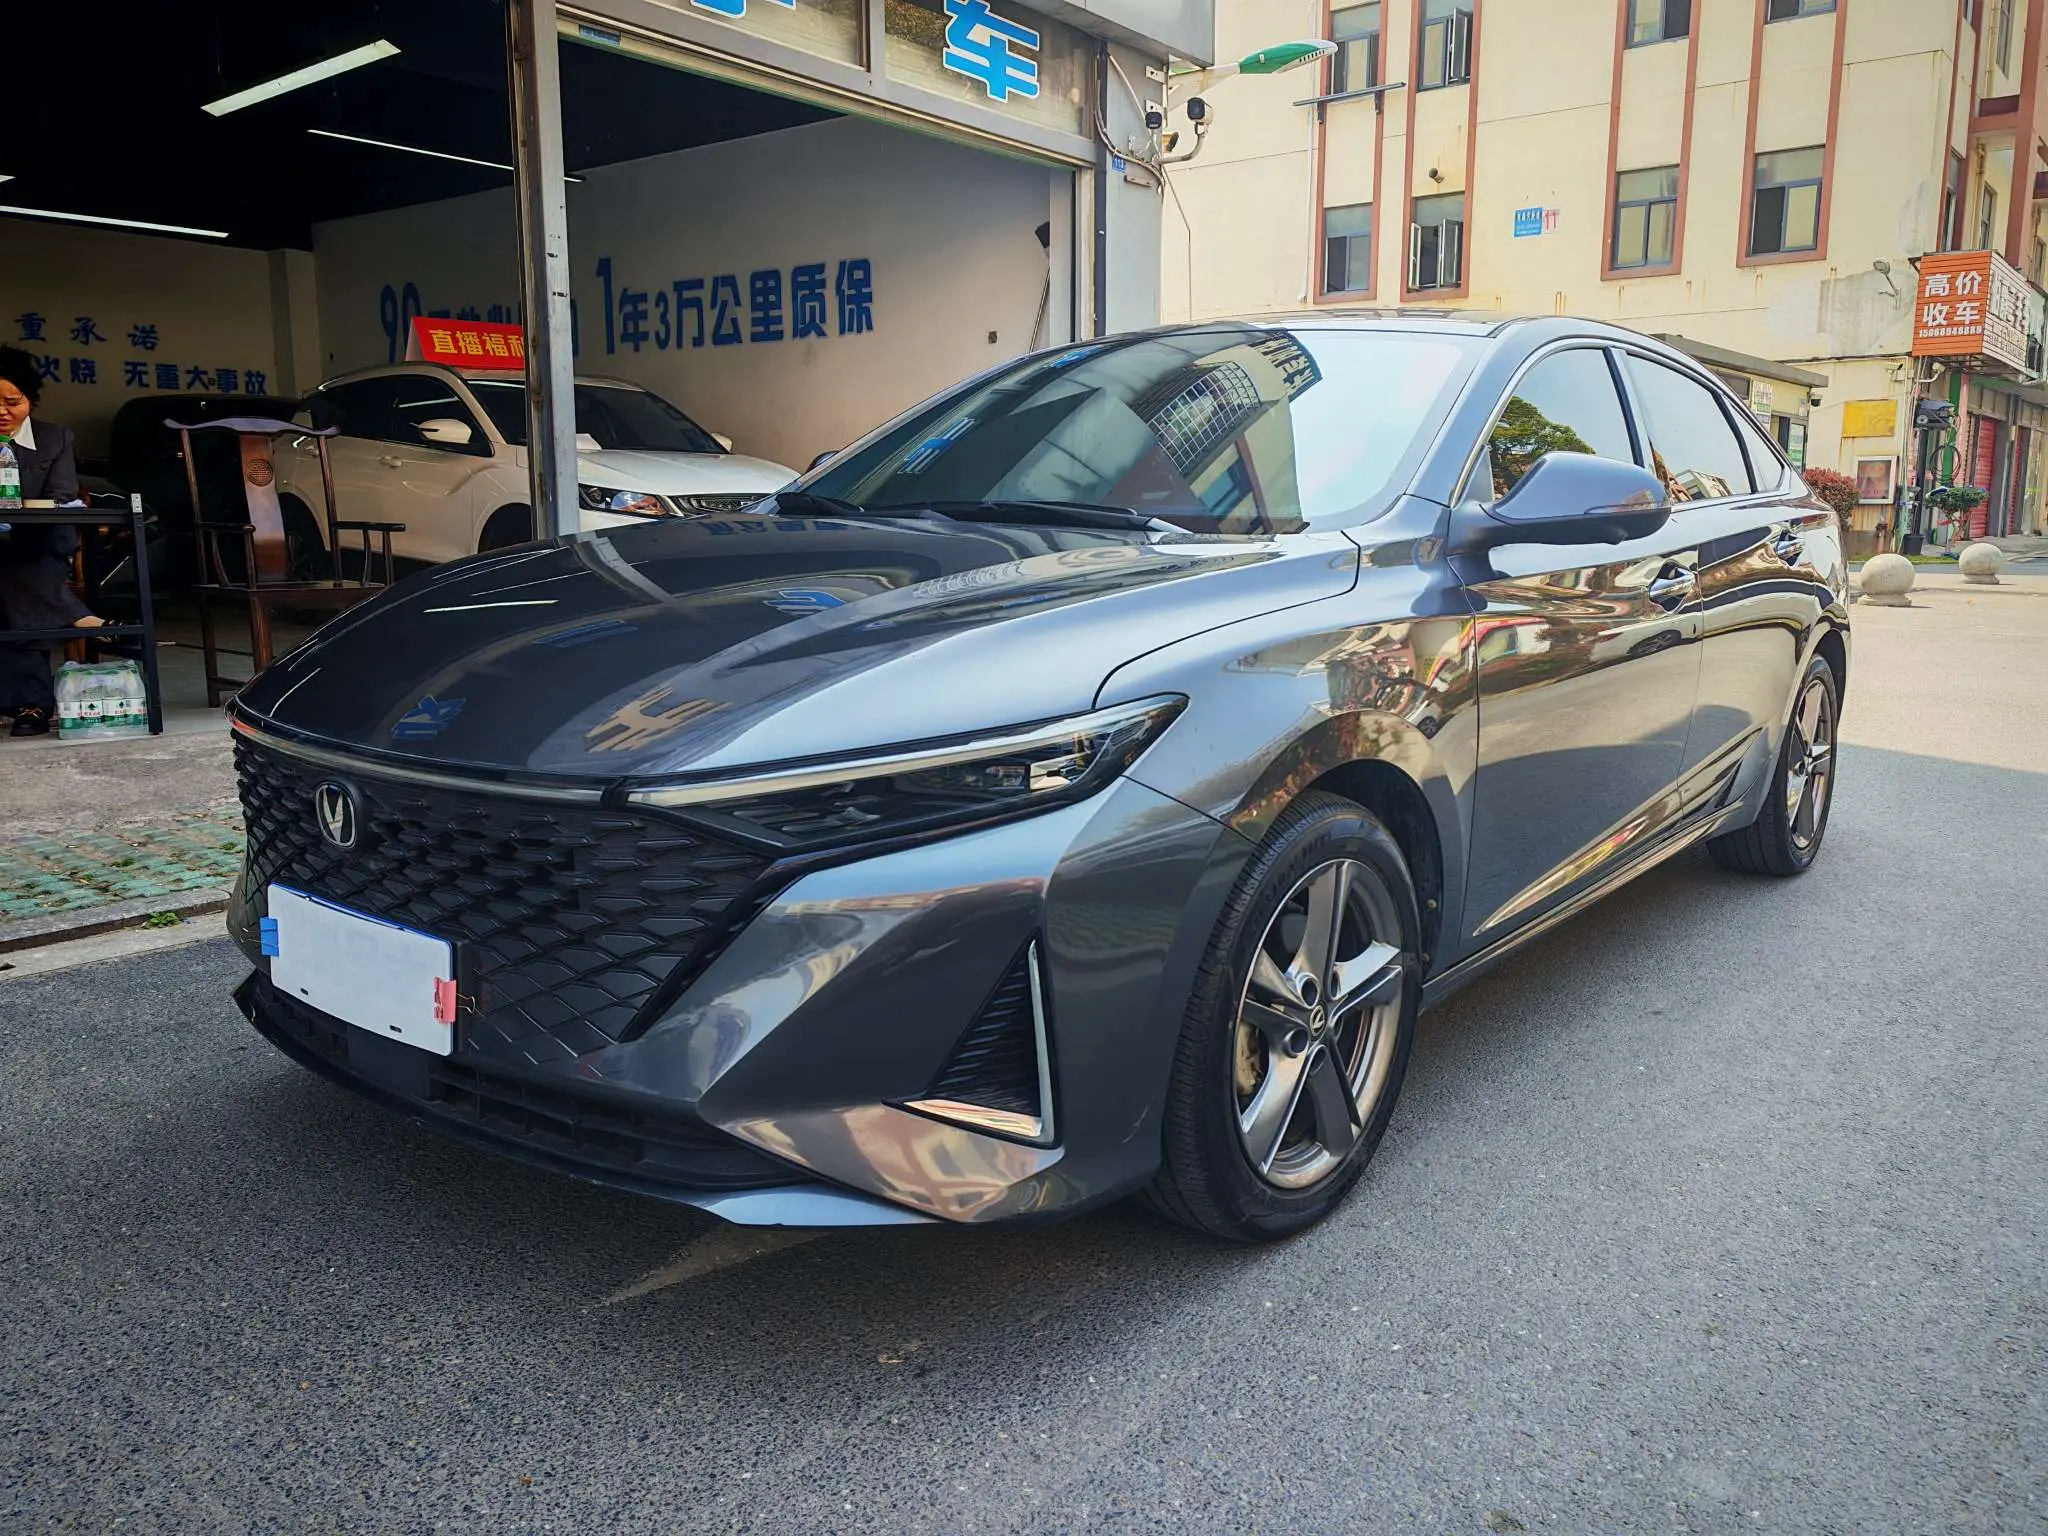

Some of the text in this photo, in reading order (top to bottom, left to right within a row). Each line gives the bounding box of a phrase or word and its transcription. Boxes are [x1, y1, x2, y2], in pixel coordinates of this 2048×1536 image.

[1924, 270, 1982, 297] 高价
[596, 257, 874, 355] 1年3万公里质保
[1923, 300, 1981, 327] 收车
[123, 360, 268, 396] 无重大事故
